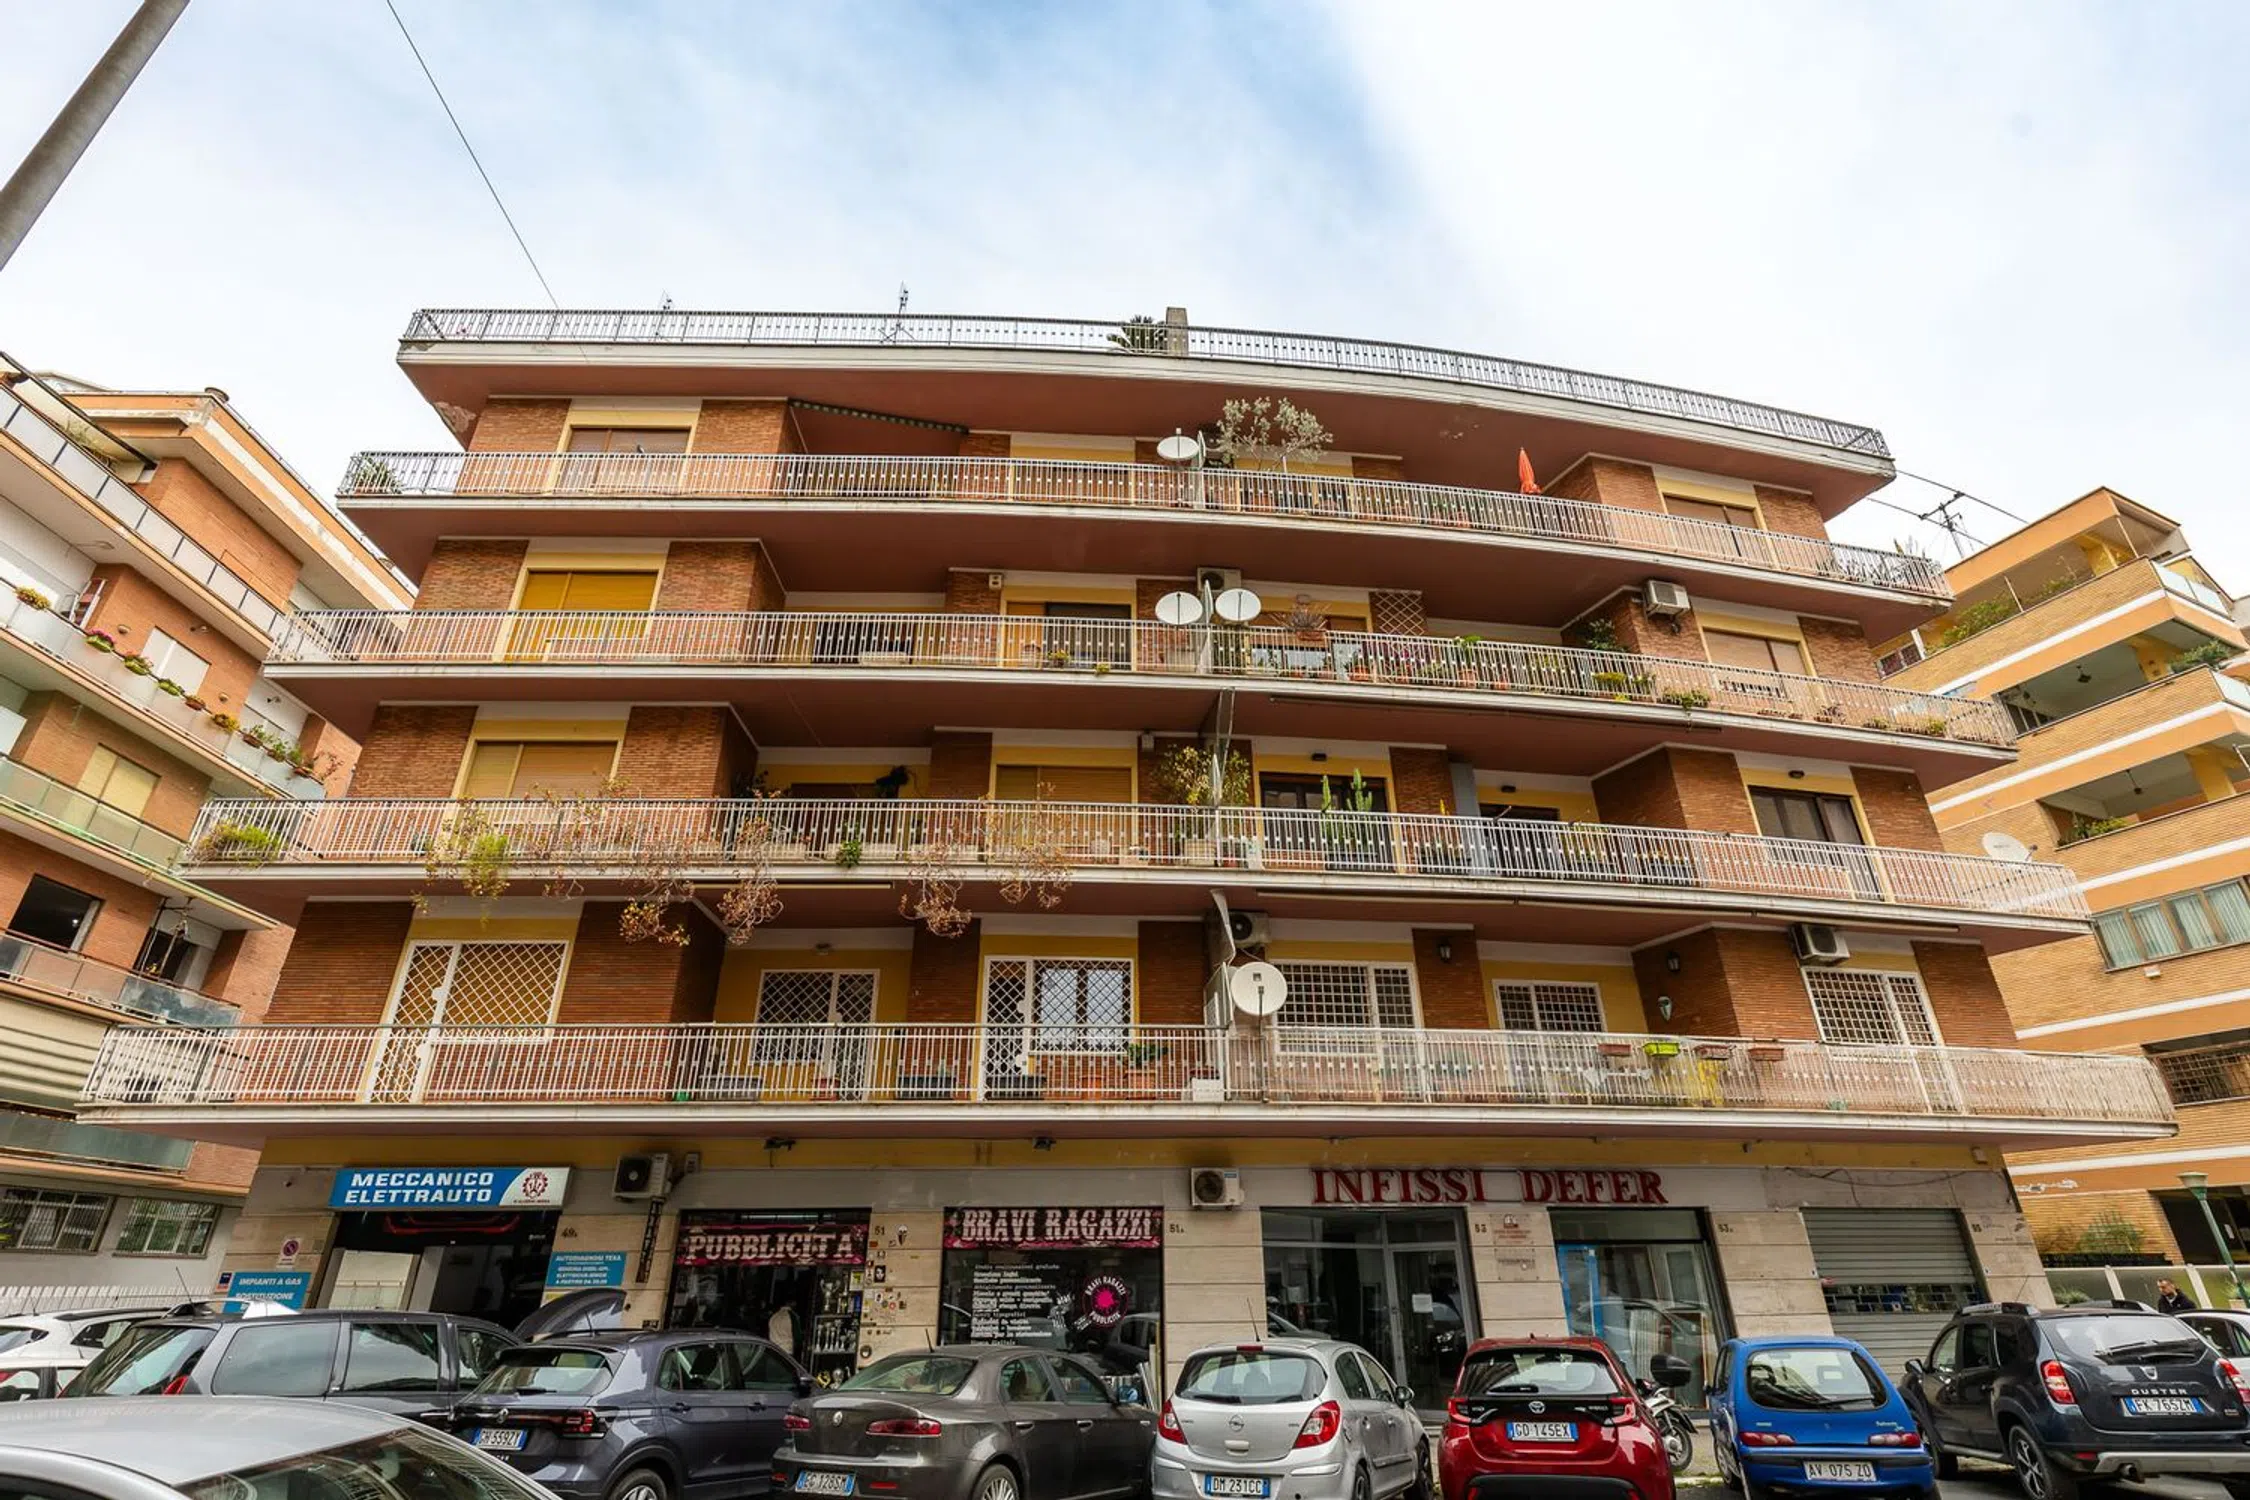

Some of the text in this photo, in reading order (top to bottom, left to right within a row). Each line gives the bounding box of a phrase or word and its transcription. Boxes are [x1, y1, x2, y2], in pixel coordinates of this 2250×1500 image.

[351, 1172, 494, 1187] MECCANICO
[1311, 1168, 1669, 1204] INFISSI DEFER
[344, 1189, 493, 1204] ELETTRAUTO
[874, 1225, 886, 1236] 51
[961, 1208, 1153, 1241] BRAVI RAGAZZI
[238, 1277, 303, 1286] IMPIANTI A GAS
[1809, 1464, 1823, 1477] AV
[1828, 1464, 1853, 1477] 075
[1213, 1477, 1262, 1494] DM 231CC
